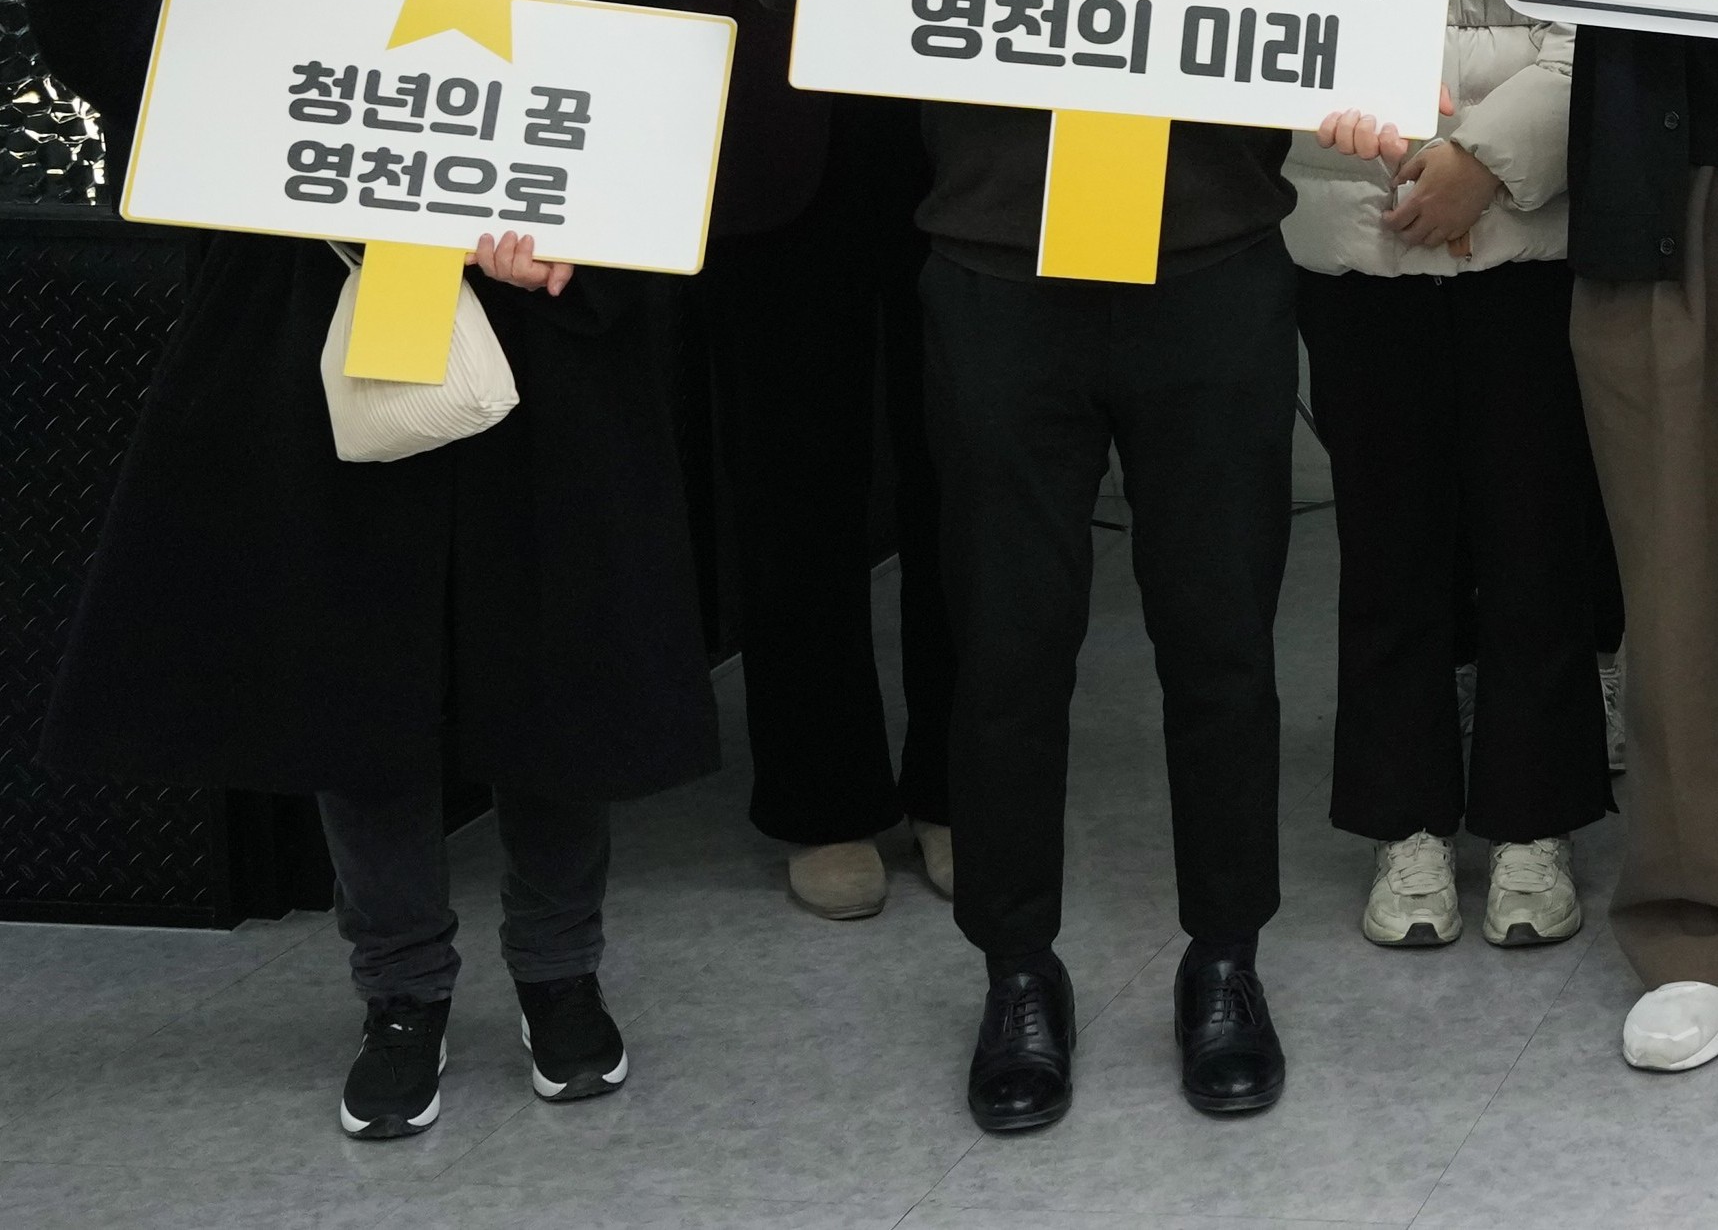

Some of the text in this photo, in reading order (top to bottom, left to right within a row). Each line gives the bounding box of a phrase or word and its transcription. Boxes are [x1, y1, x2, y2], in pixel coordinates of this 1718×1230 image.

[1180, 6, 1339, 89] 미래
[288, 60, 591, 150] 청년의 꿈
[285, 140, 569, 225] 영천으로
